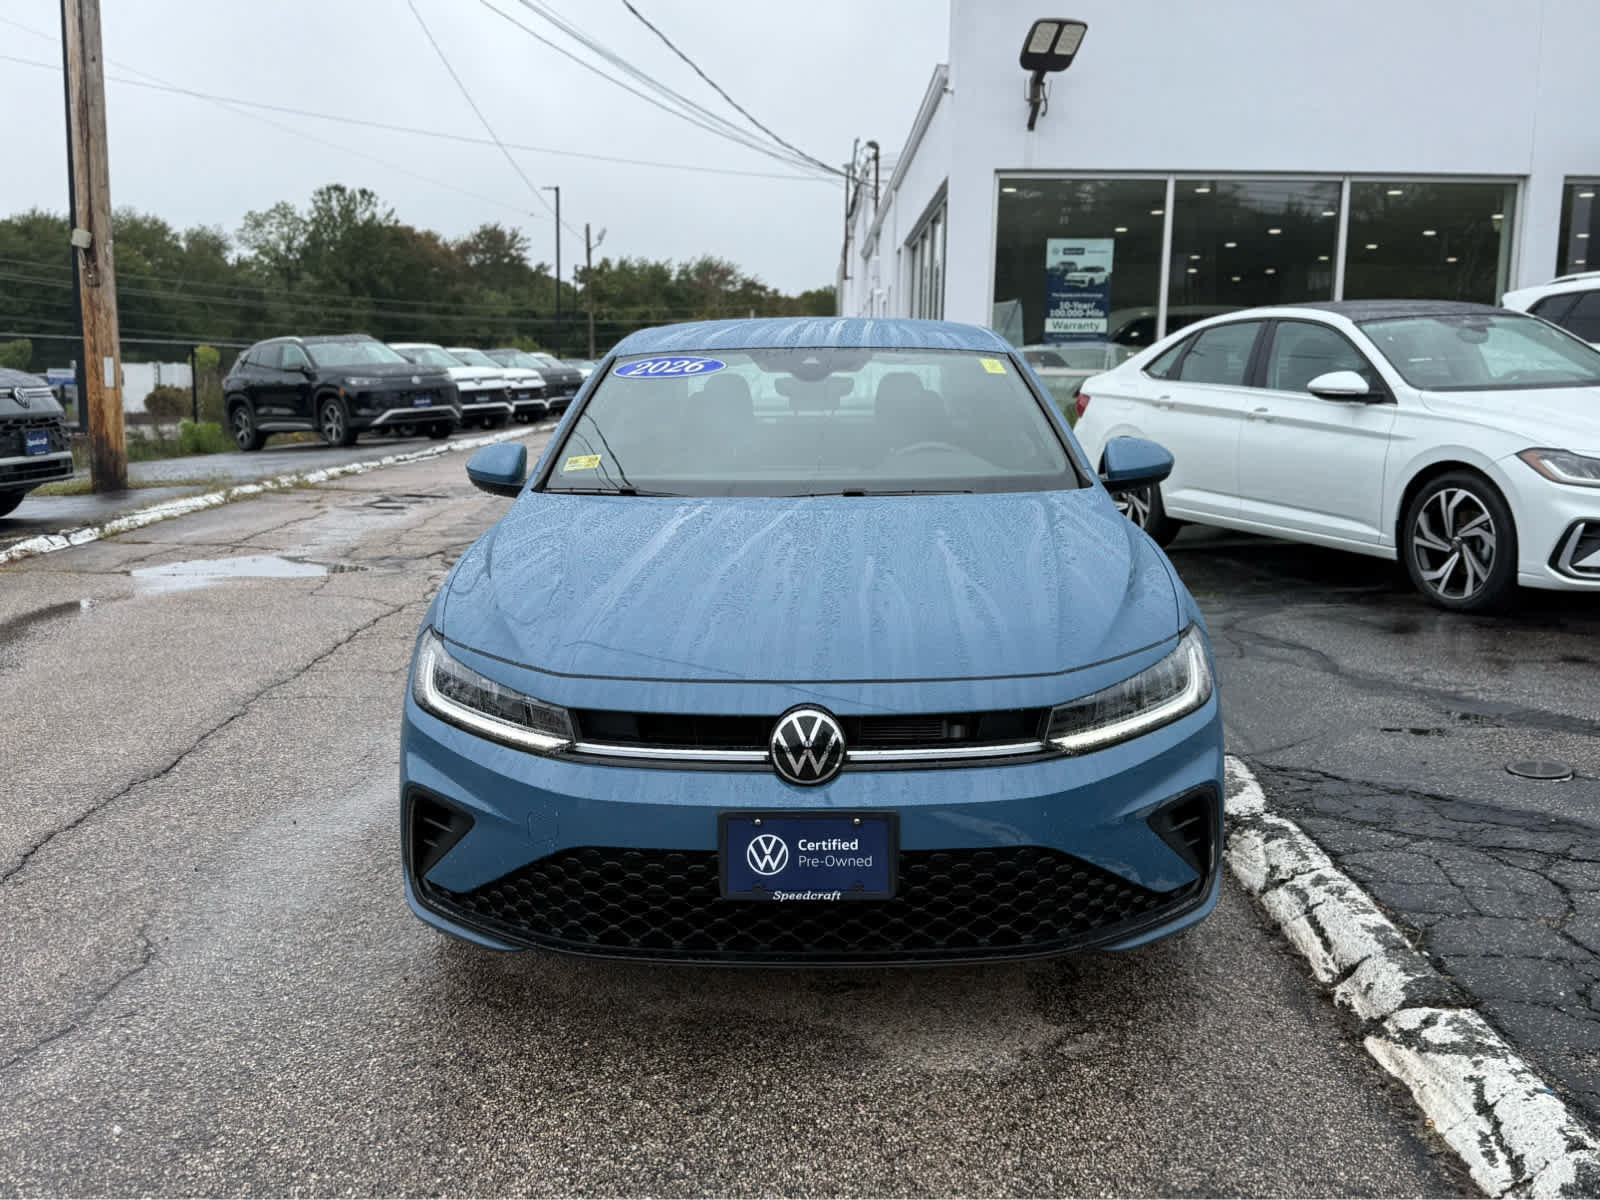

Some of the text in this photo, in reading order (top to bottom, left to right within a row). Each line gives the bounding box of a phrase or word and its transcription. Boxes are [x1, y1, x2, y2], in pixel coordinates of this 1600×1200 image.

[1052, 320, 1100, 331] Warranty
[627, 360, 704, 375] 2026
[798, 838, 859, 851] Certified
[798, 855, 873, 867] Pre-Owned
[773, 891, 841, 901] Speedcraft
